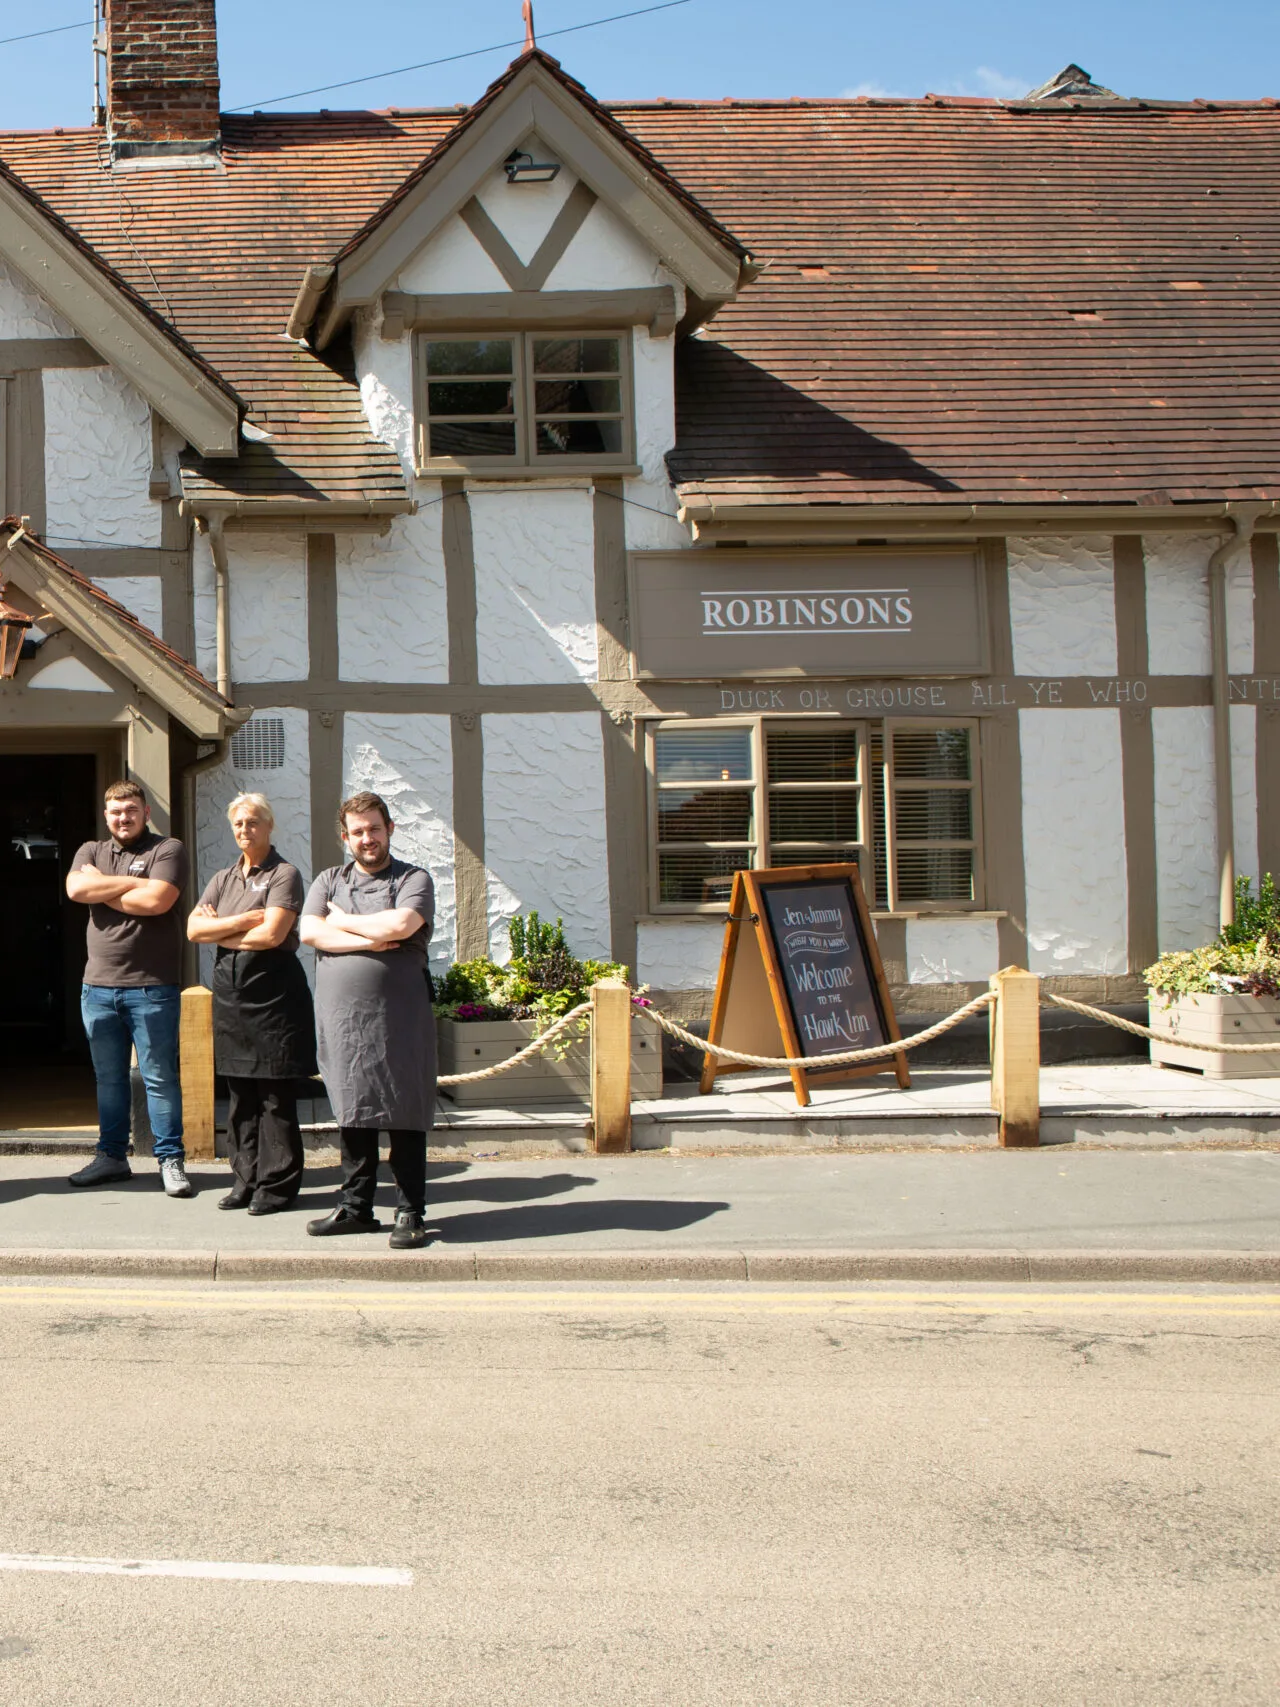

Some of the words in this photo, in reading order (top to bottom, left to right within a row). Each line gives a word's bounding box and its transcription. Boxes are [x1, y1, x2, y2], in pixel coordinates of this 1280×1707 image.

[701, 597, 913, 627] ROBINSONS
[721, 689, 785, 709] DUCK
[799, 689, 833, 708] OR
[846, 686, 947, 708] GROUSE
[971, 681, 1016, 705] ALL
[1028, 681, 1063, 704] YE
[1086, 680, 1147, 702] WHO
[808, 936, 822, 948] YOU
[823, 939, 829, 948] A
[790, 962, 854, 993] Welcome
[817, 996, 827, 1005] TO
[828, 994, 842, 1003] THE
[804, 1011, 860, 1042] Hawk
[845, 1009, 871, 1034] Inn
